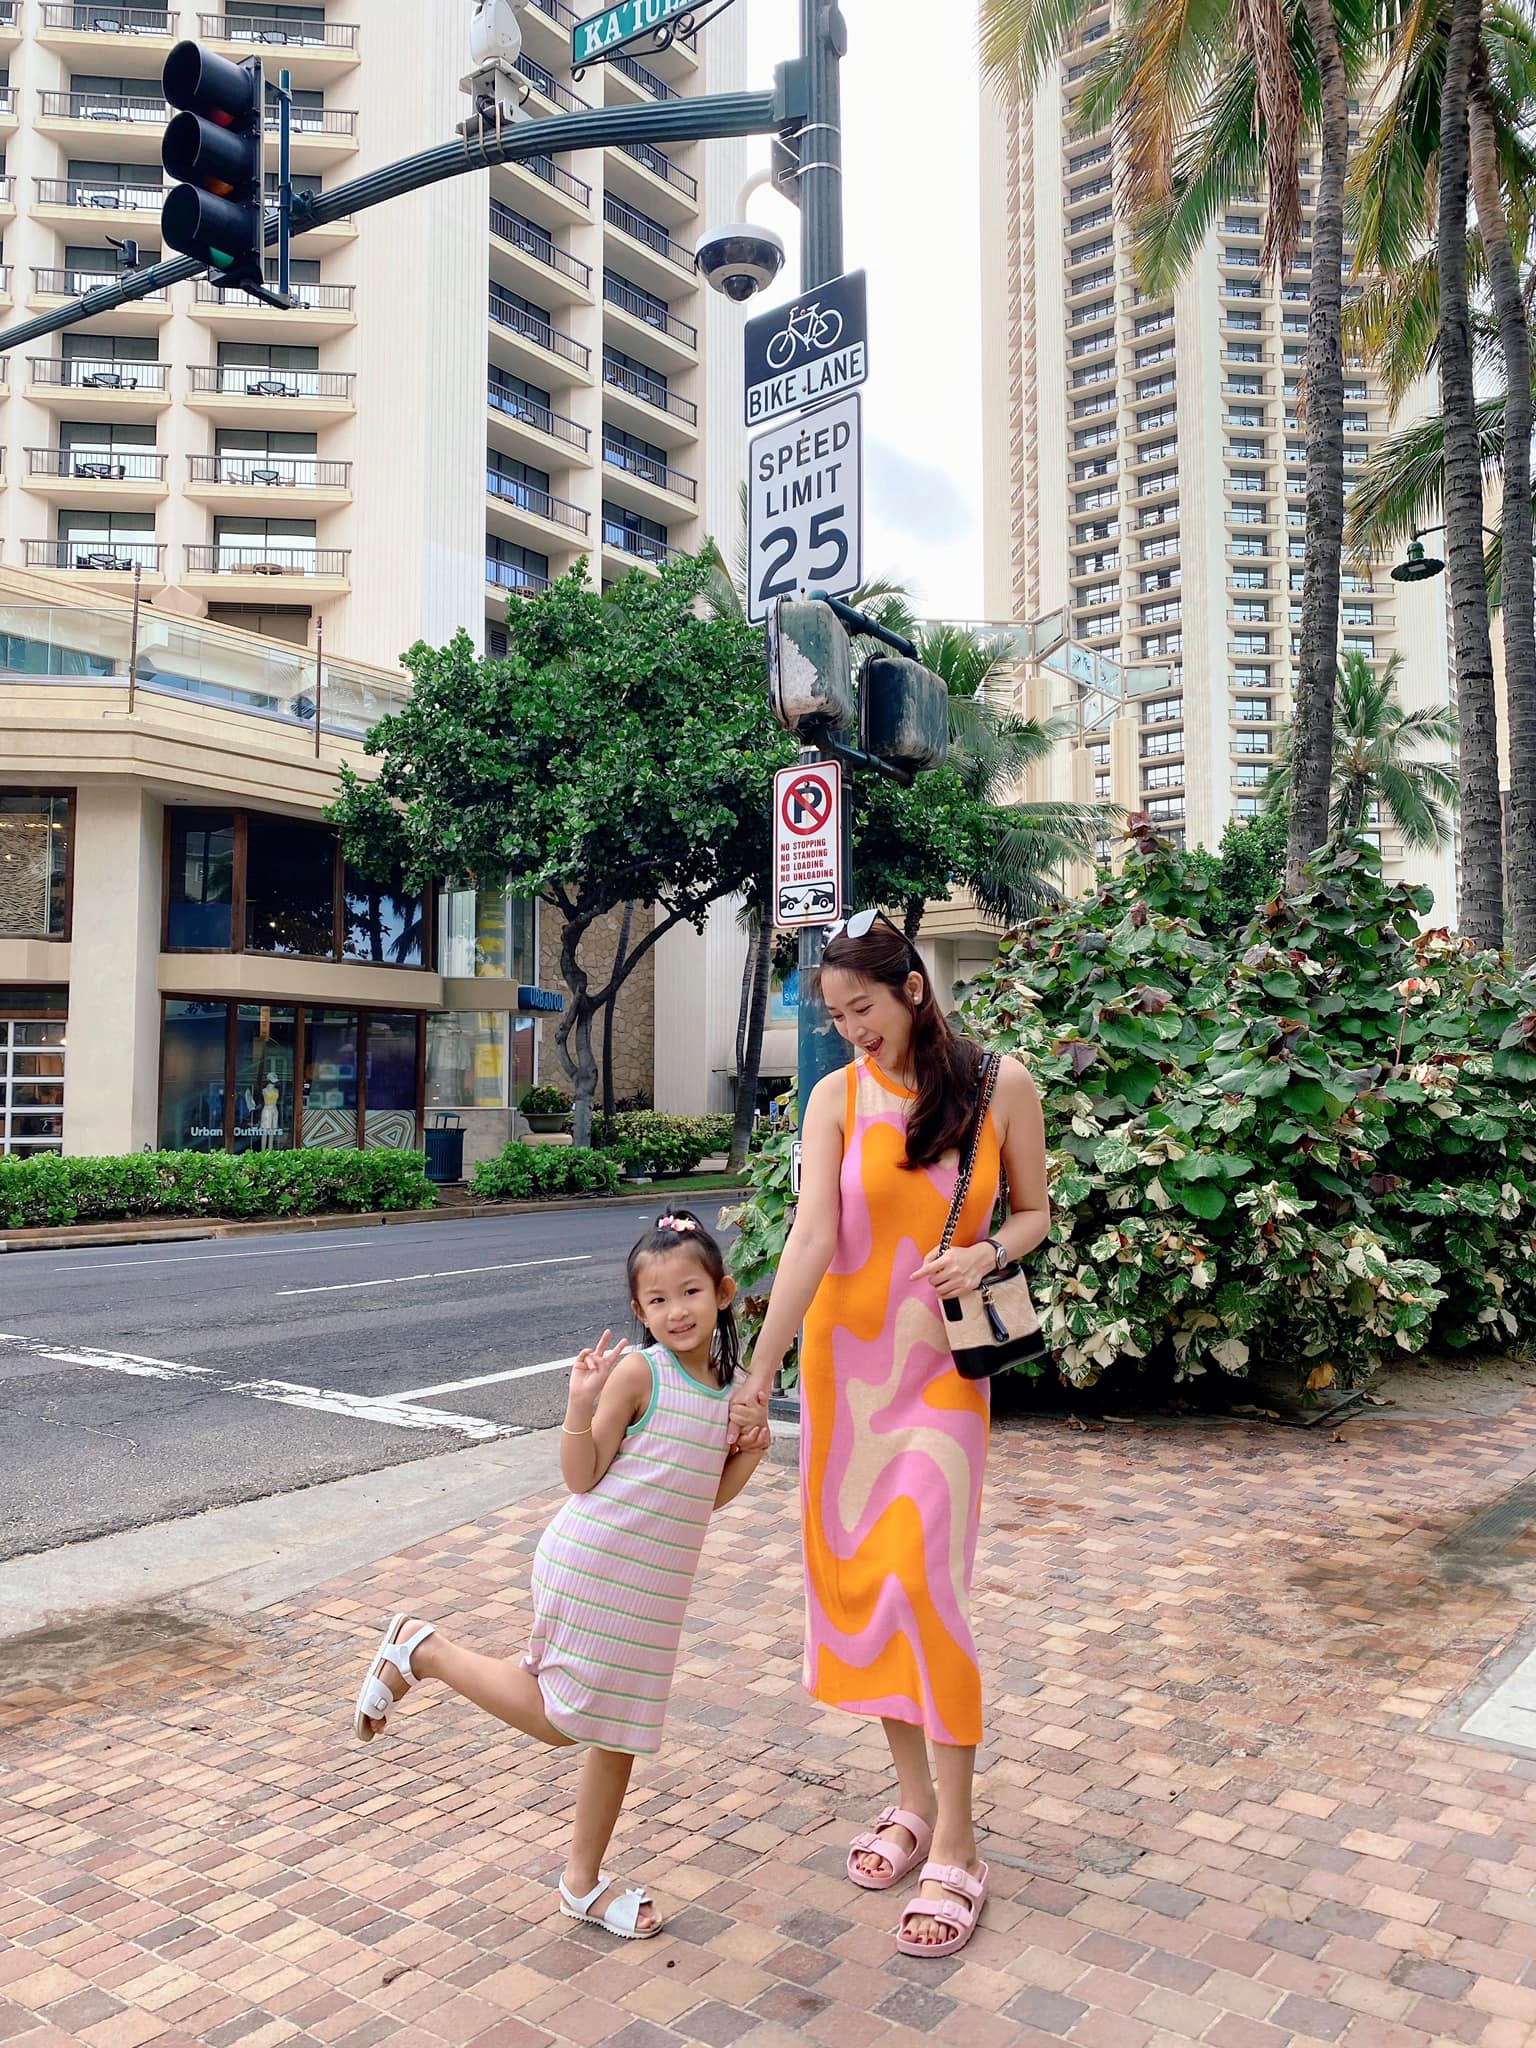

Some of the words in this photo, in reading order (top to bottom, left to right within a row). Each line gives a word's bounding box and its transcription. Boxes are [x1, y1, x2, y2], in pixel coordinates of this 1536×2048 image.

[749, 374, 797, 418] BIKE
[806, 347, 862, 395] LANE
[758, 420, 851, 482] SPEED
[766, 462, 842, 519] LIMIT
[758, 504, 849, 602] 25
[793, 786, 822, 824] P
[780, 843, 790, 851] NO
[793, 838, 826, 850] STOPPING
[780, 853, 790, 862] NO
[793, 848, 828, 860] STANDING
[780, 864, 790, 872] NO
[793, 859, 824, 871] LOADING
[780, 874, 790, 882] NO
[793, 869, 833, 881] UNLOADING
[190, 1127, 223, 1137] Urban
[233, 1127, 283, 1137] Outfitters
